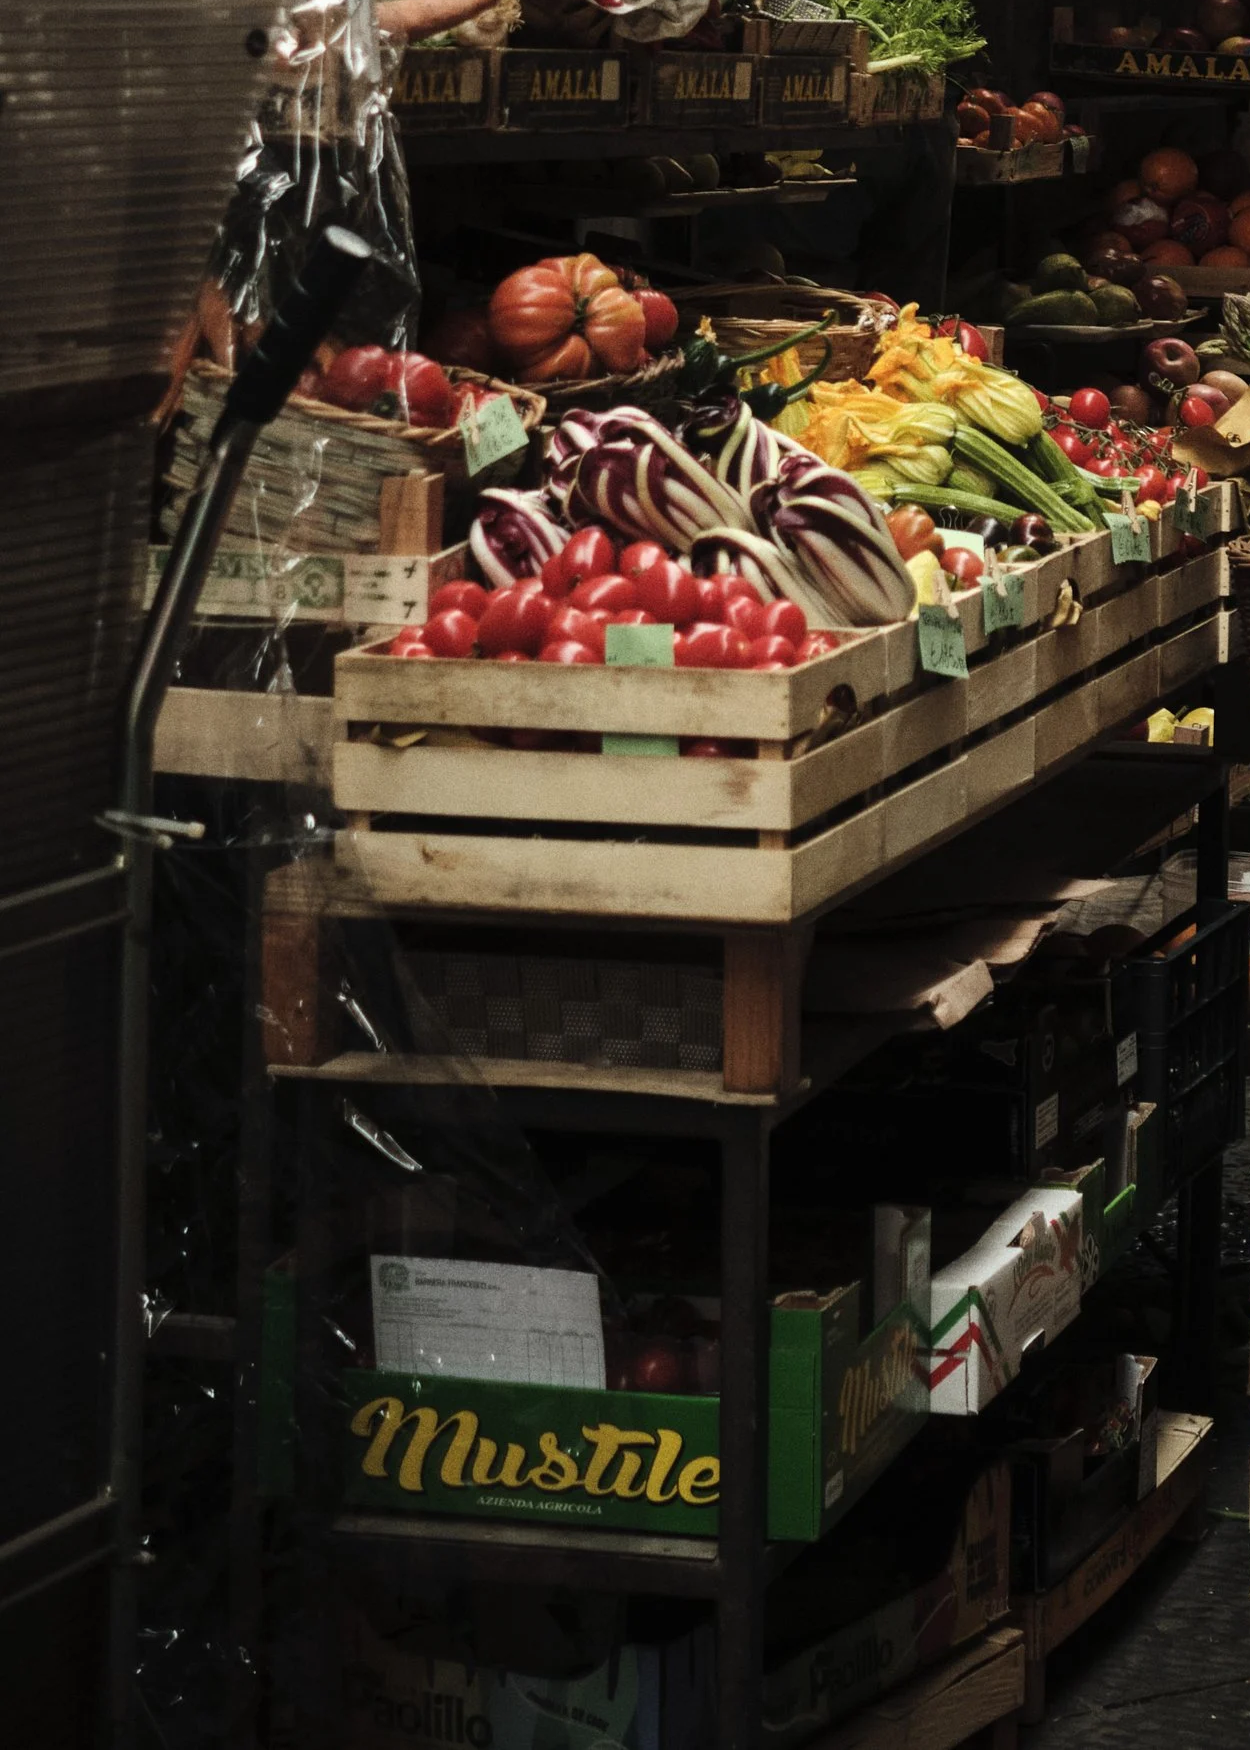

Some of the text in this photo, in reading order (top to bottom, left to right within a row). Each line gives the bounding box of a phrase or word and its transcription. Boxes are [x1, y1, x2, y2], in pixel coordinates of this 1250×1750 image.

[529, 68, 602, 102] AMALA
[674, 69, 733, 100] AMALA
[781, 72, 833, 103] AMALA
[349, 1394, 721, 1508] Mustile
[475, 1494, 603, 1517] AZIENDA AGRICOLA
